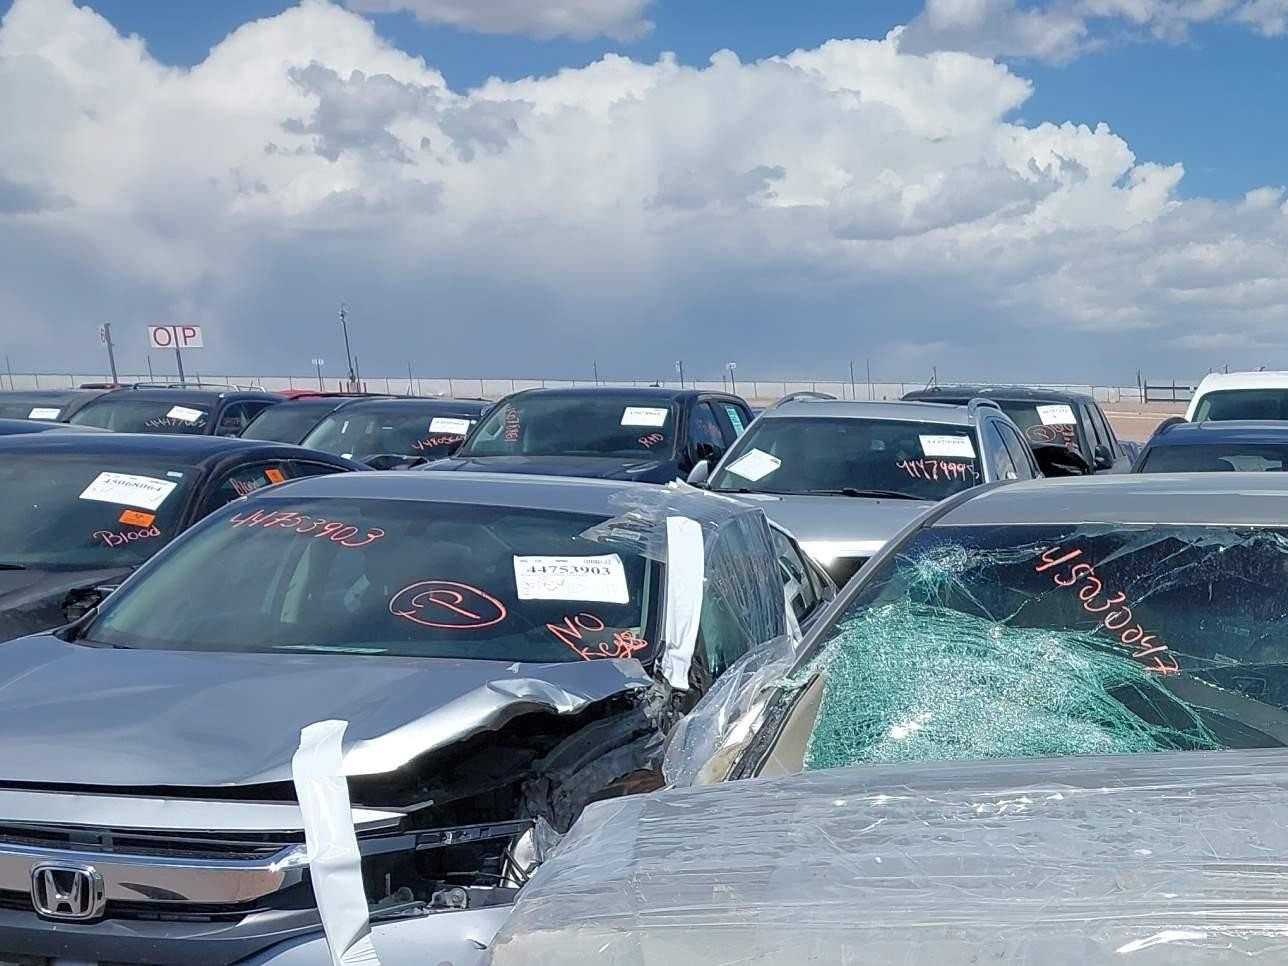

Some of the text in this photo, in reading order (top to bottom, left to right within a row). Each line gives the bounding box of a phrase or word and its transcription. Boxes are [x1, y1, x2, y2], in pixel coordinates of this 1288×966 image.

[92, 525, 161, 547] Blood
[229, 509, 385, 547] 44753903
[526, 565, 611, 576] 44753903
[1035, 546, 1181, 676] 45030047
